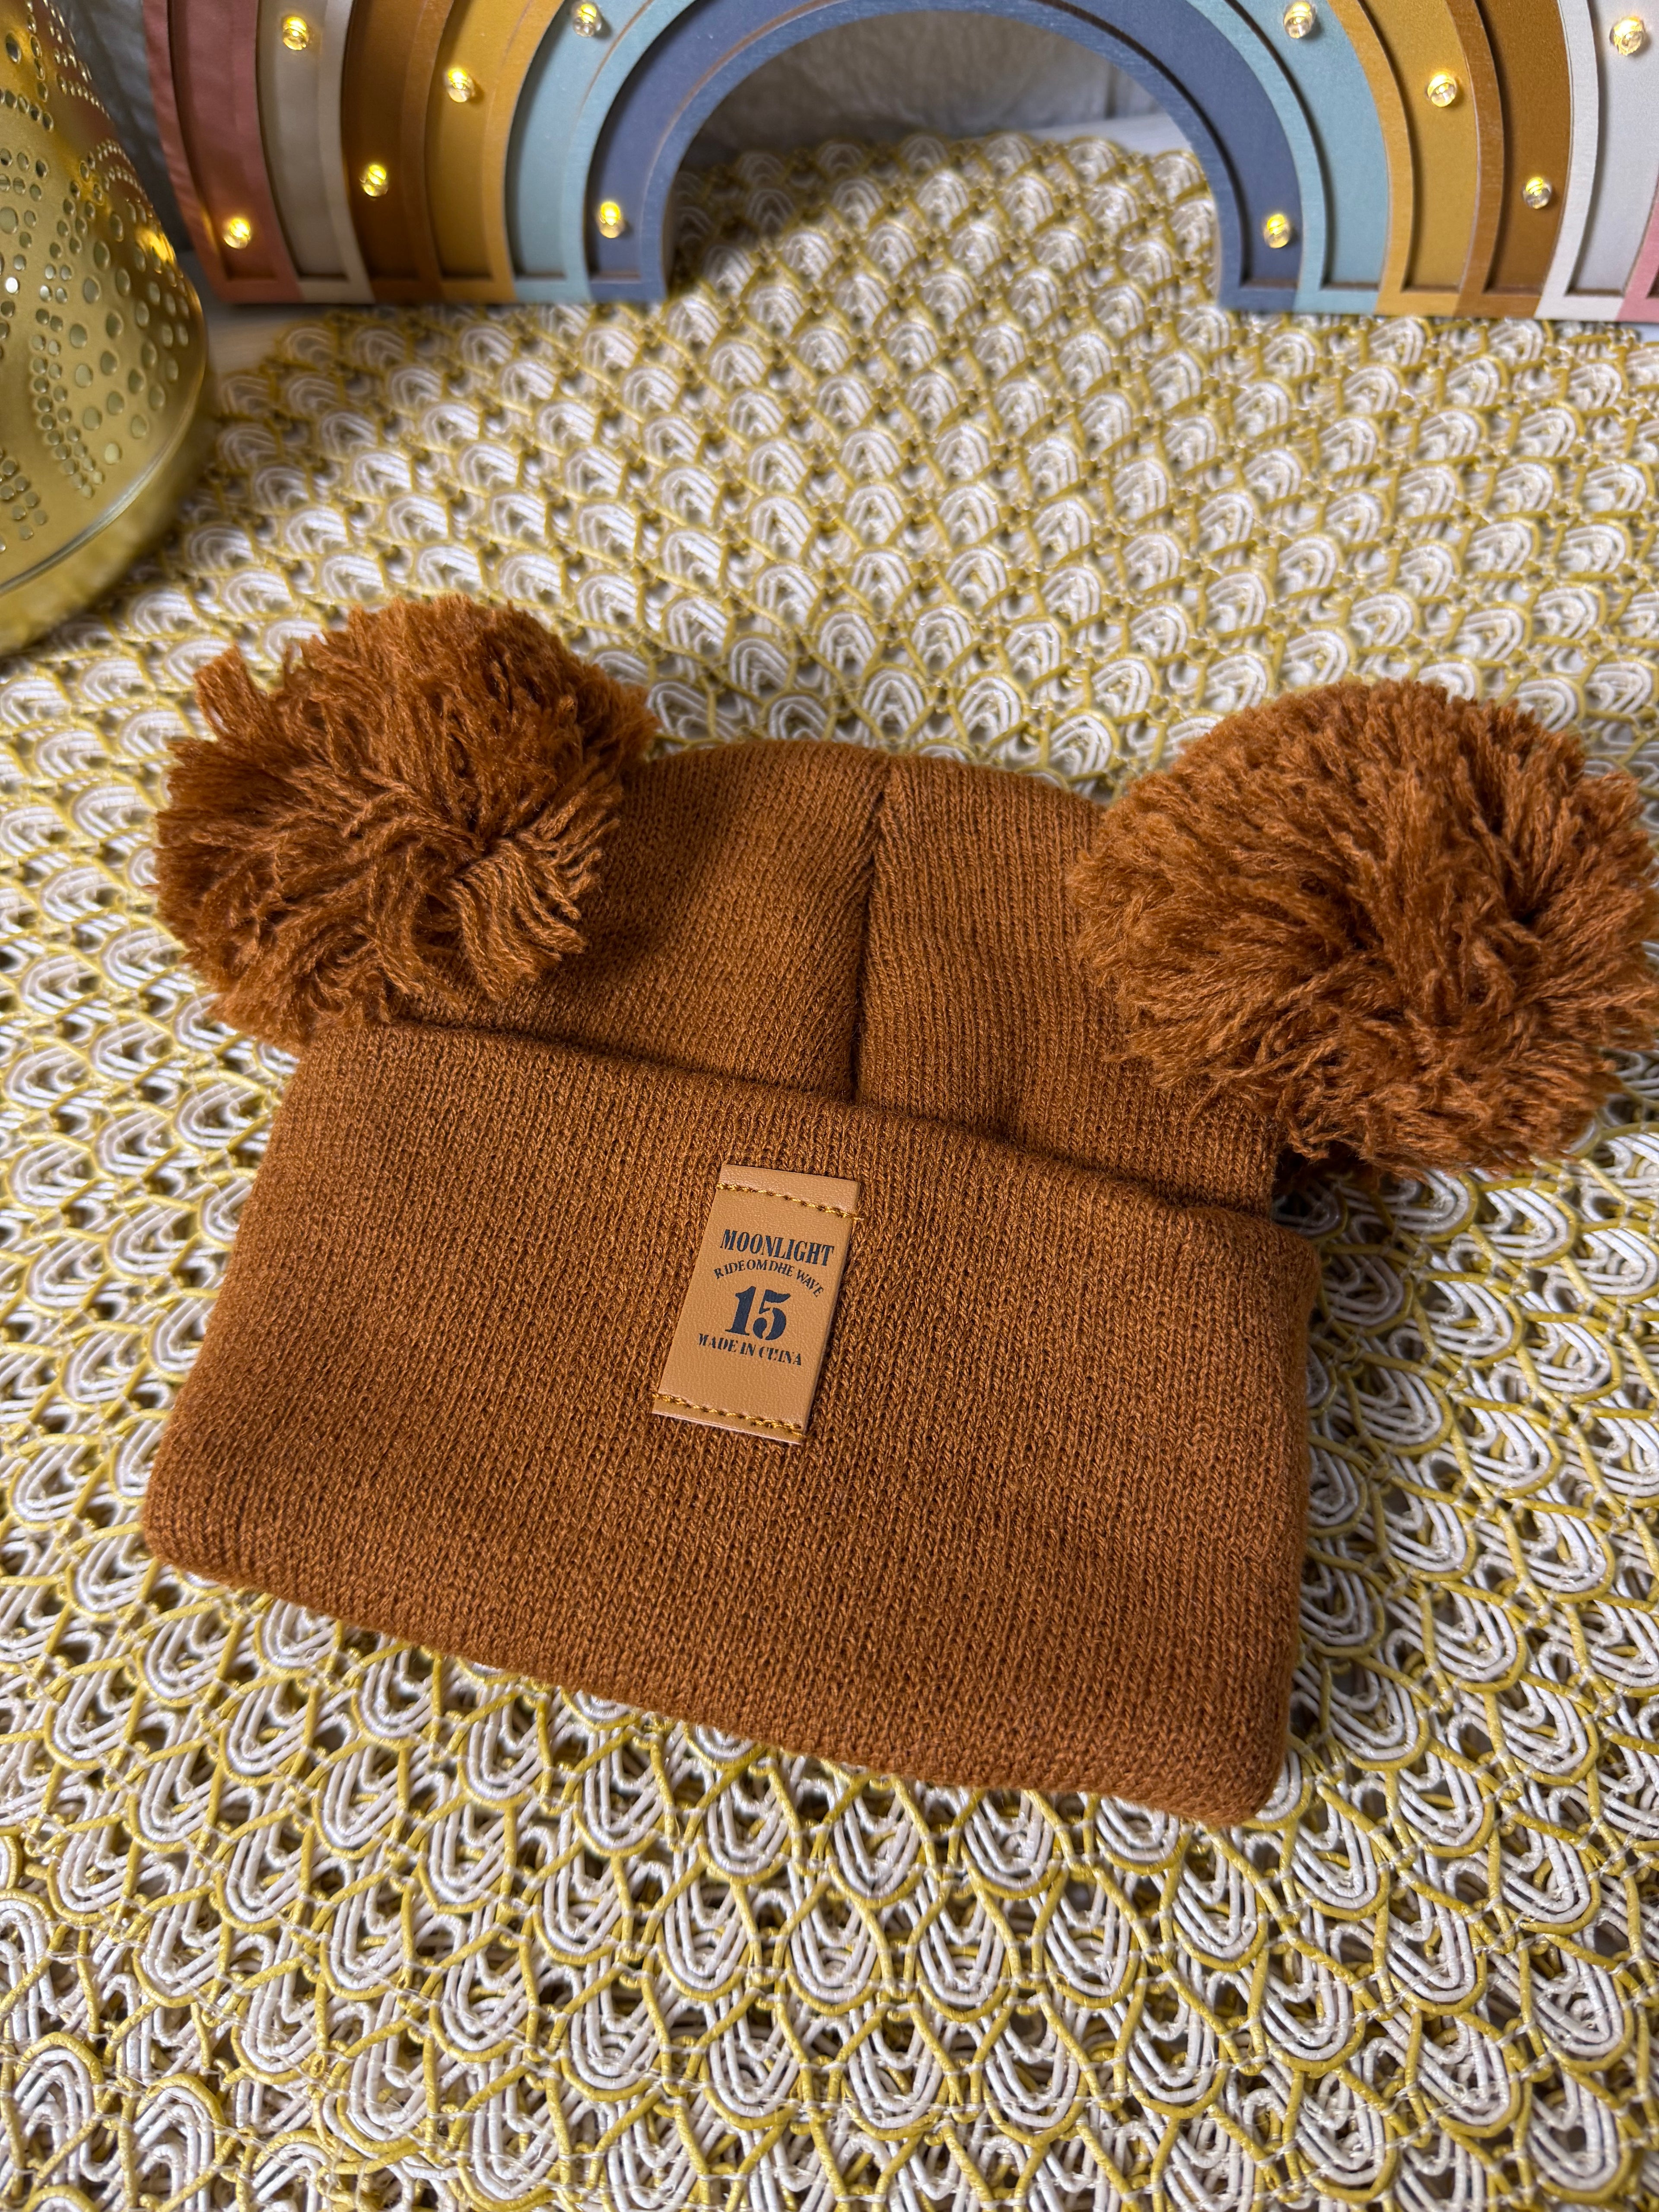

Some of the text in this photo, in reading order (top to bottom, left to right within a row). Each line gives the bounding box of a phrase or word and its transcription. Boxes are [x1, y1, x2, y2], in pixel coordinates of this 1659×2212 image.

[719, 1228, 835, 1266] MOONLIGHT
[796, 1268, 824, 1298] WAVE
[725, 1285, 791, 1341] 15
[699, 1333, 802, 1366] MADE IN CHINA
